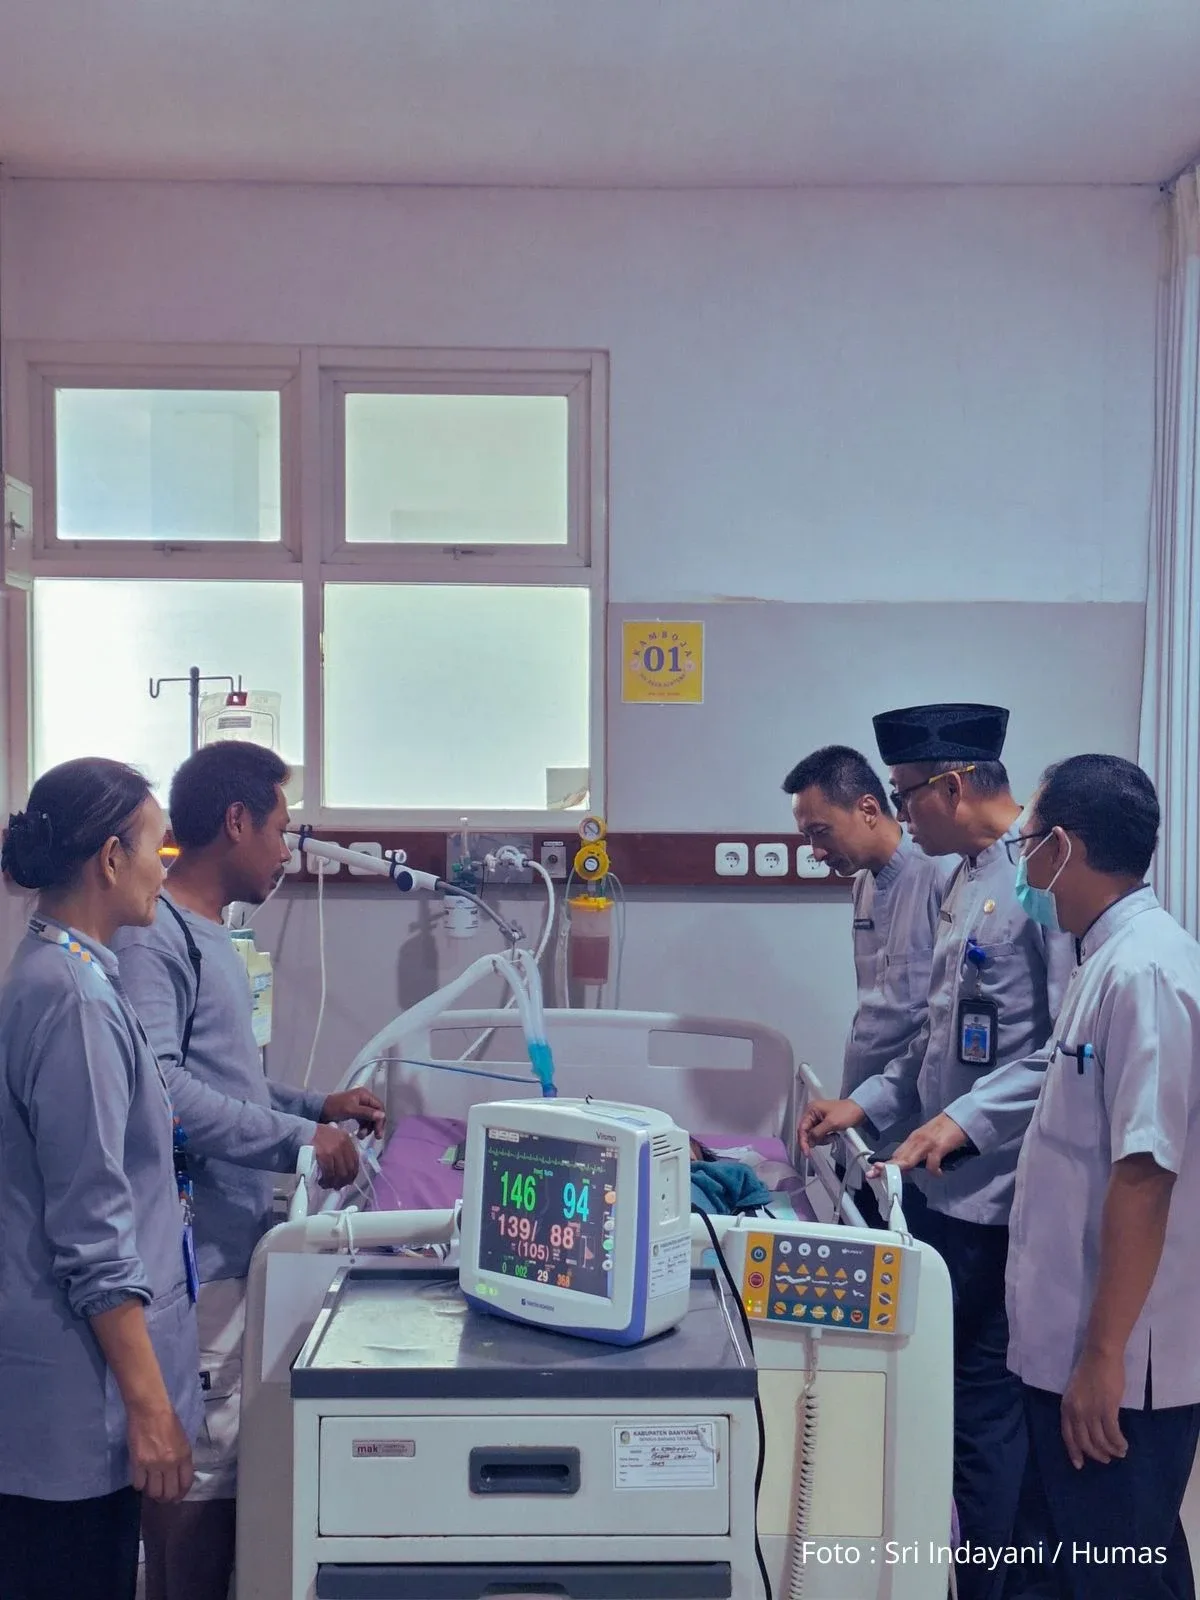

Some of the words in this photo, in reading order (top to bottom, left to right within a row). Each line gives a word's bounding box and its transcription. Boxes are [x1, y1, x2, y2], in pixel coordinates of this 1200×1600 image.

[632, 631, 692, 657] KAMBOJA
[643, 646, 682, 672] 01
[501, 1170, 536, 1211] 146
[563, 1182, 589, 1222] 94
[550, 1224, 574, 1249] 88
[517, 1241, 550, 1261] (105)
[537, 1269, 549, 1283] 29
[357, 1444, 378, 1453] mak
